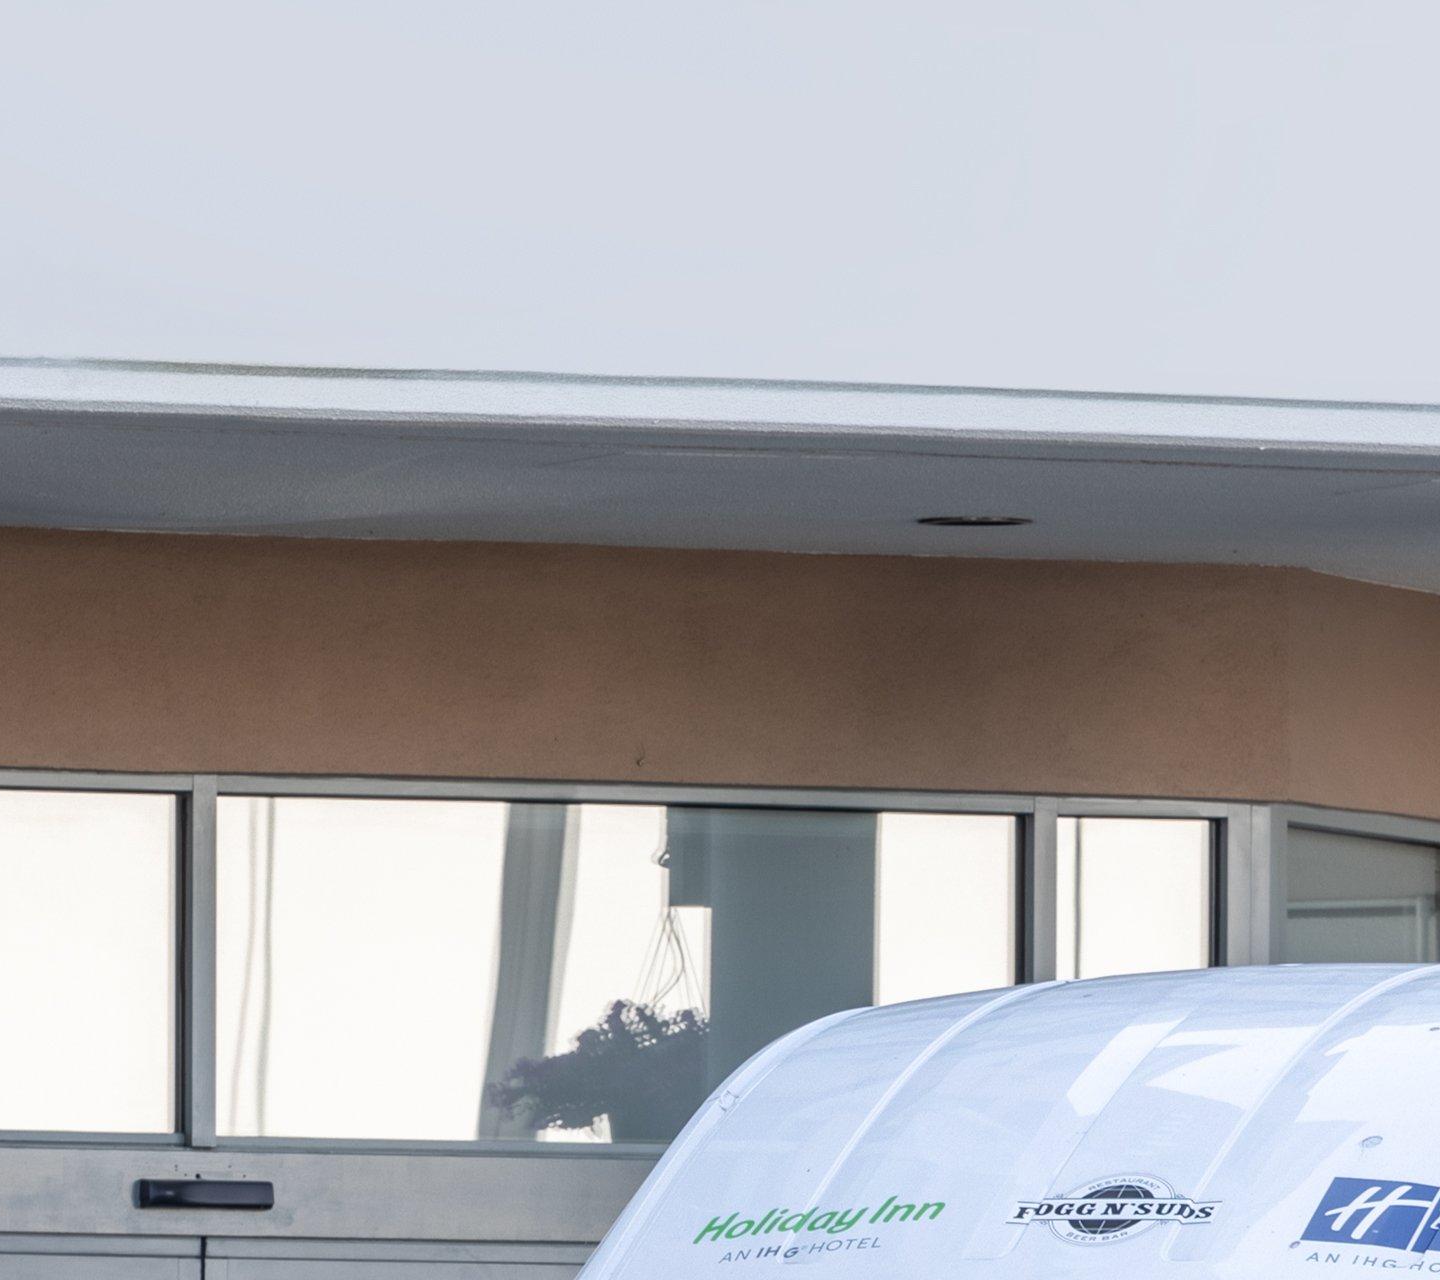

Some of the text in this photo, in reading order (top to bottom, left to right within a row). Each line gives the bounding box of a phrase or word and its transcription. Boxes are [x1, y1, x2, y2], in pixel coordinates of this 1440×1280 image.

[693, 1195, 945, 1244] Holiday Inn
[1014, 1202, 1215, 1219] FOGG N'SUDS
[719, 1249, 751, 1264] AN
[809, 1237, 882, 1254] HOTEL
[1306, 1252, 1340, 1263] AN
[1352, 1254, 1397, 1268] IHG
